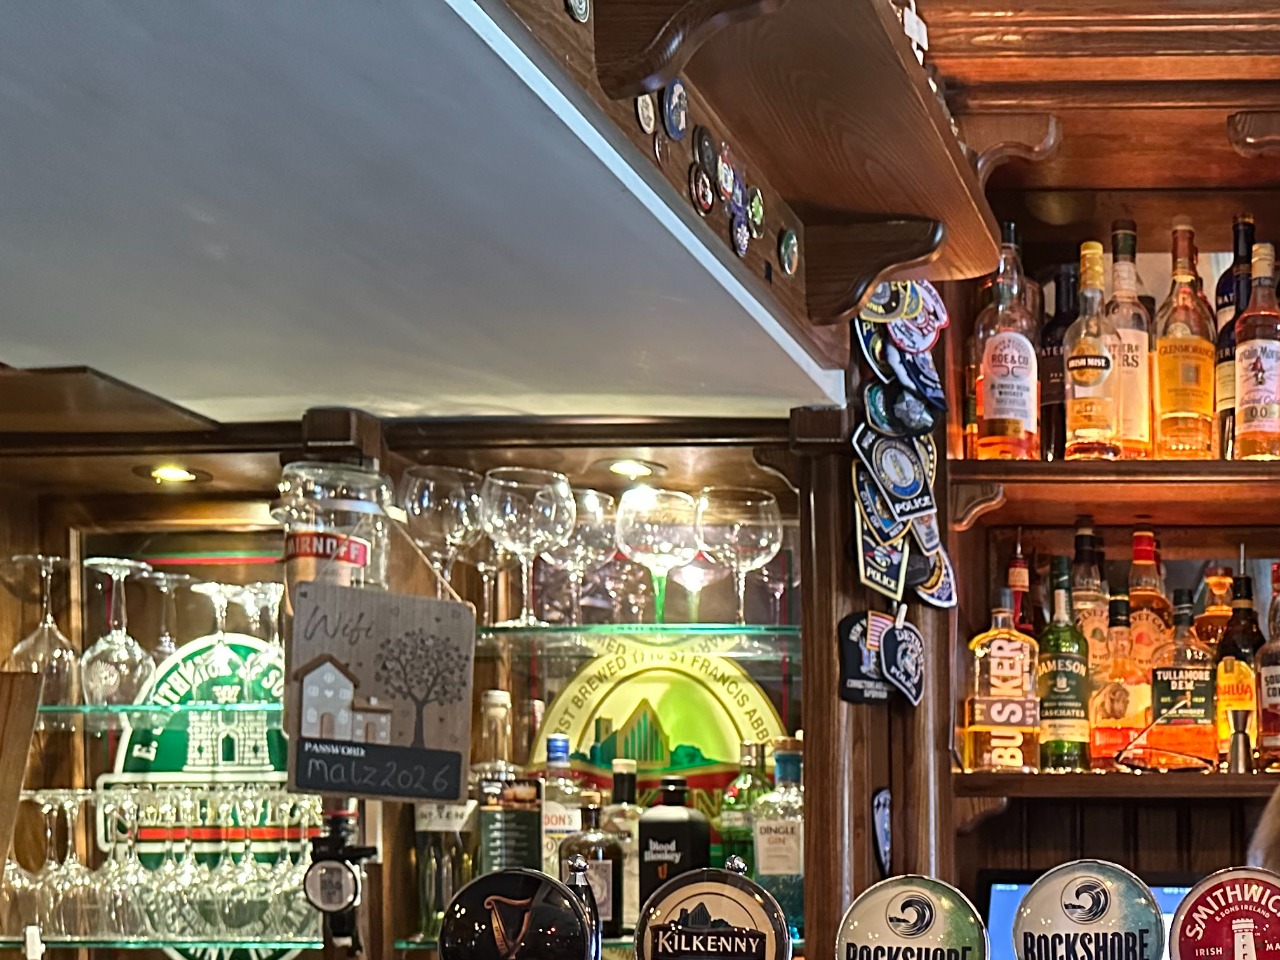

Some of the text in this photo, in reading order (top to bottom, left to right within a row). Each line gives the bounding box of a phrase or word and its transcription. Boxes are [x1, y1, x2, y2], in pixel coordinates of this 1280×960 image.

[894, 495, 932, 513] POLICE
[866, 567, 897, 591] POLICE
[304, 606, 374, 645] Wifi
[1038, 659, 1087, 677] JAMESON
[1156, 670, 1210, 681] TULLAMORE
[572, 656, 749, 709] BREWED FRANCIS
[990, 639, 1023, 767] BUSKER
[759, 826, 796, 836] DINGLE
[767, 837, 786, 845] GIN
[1220, 905, 1239, 917] SONS
[1241, 905, 1270, 918] IRELAND
[658, 931, 760, 953] KILKENNY
[1195, 947, 1223, 956] IRISH
